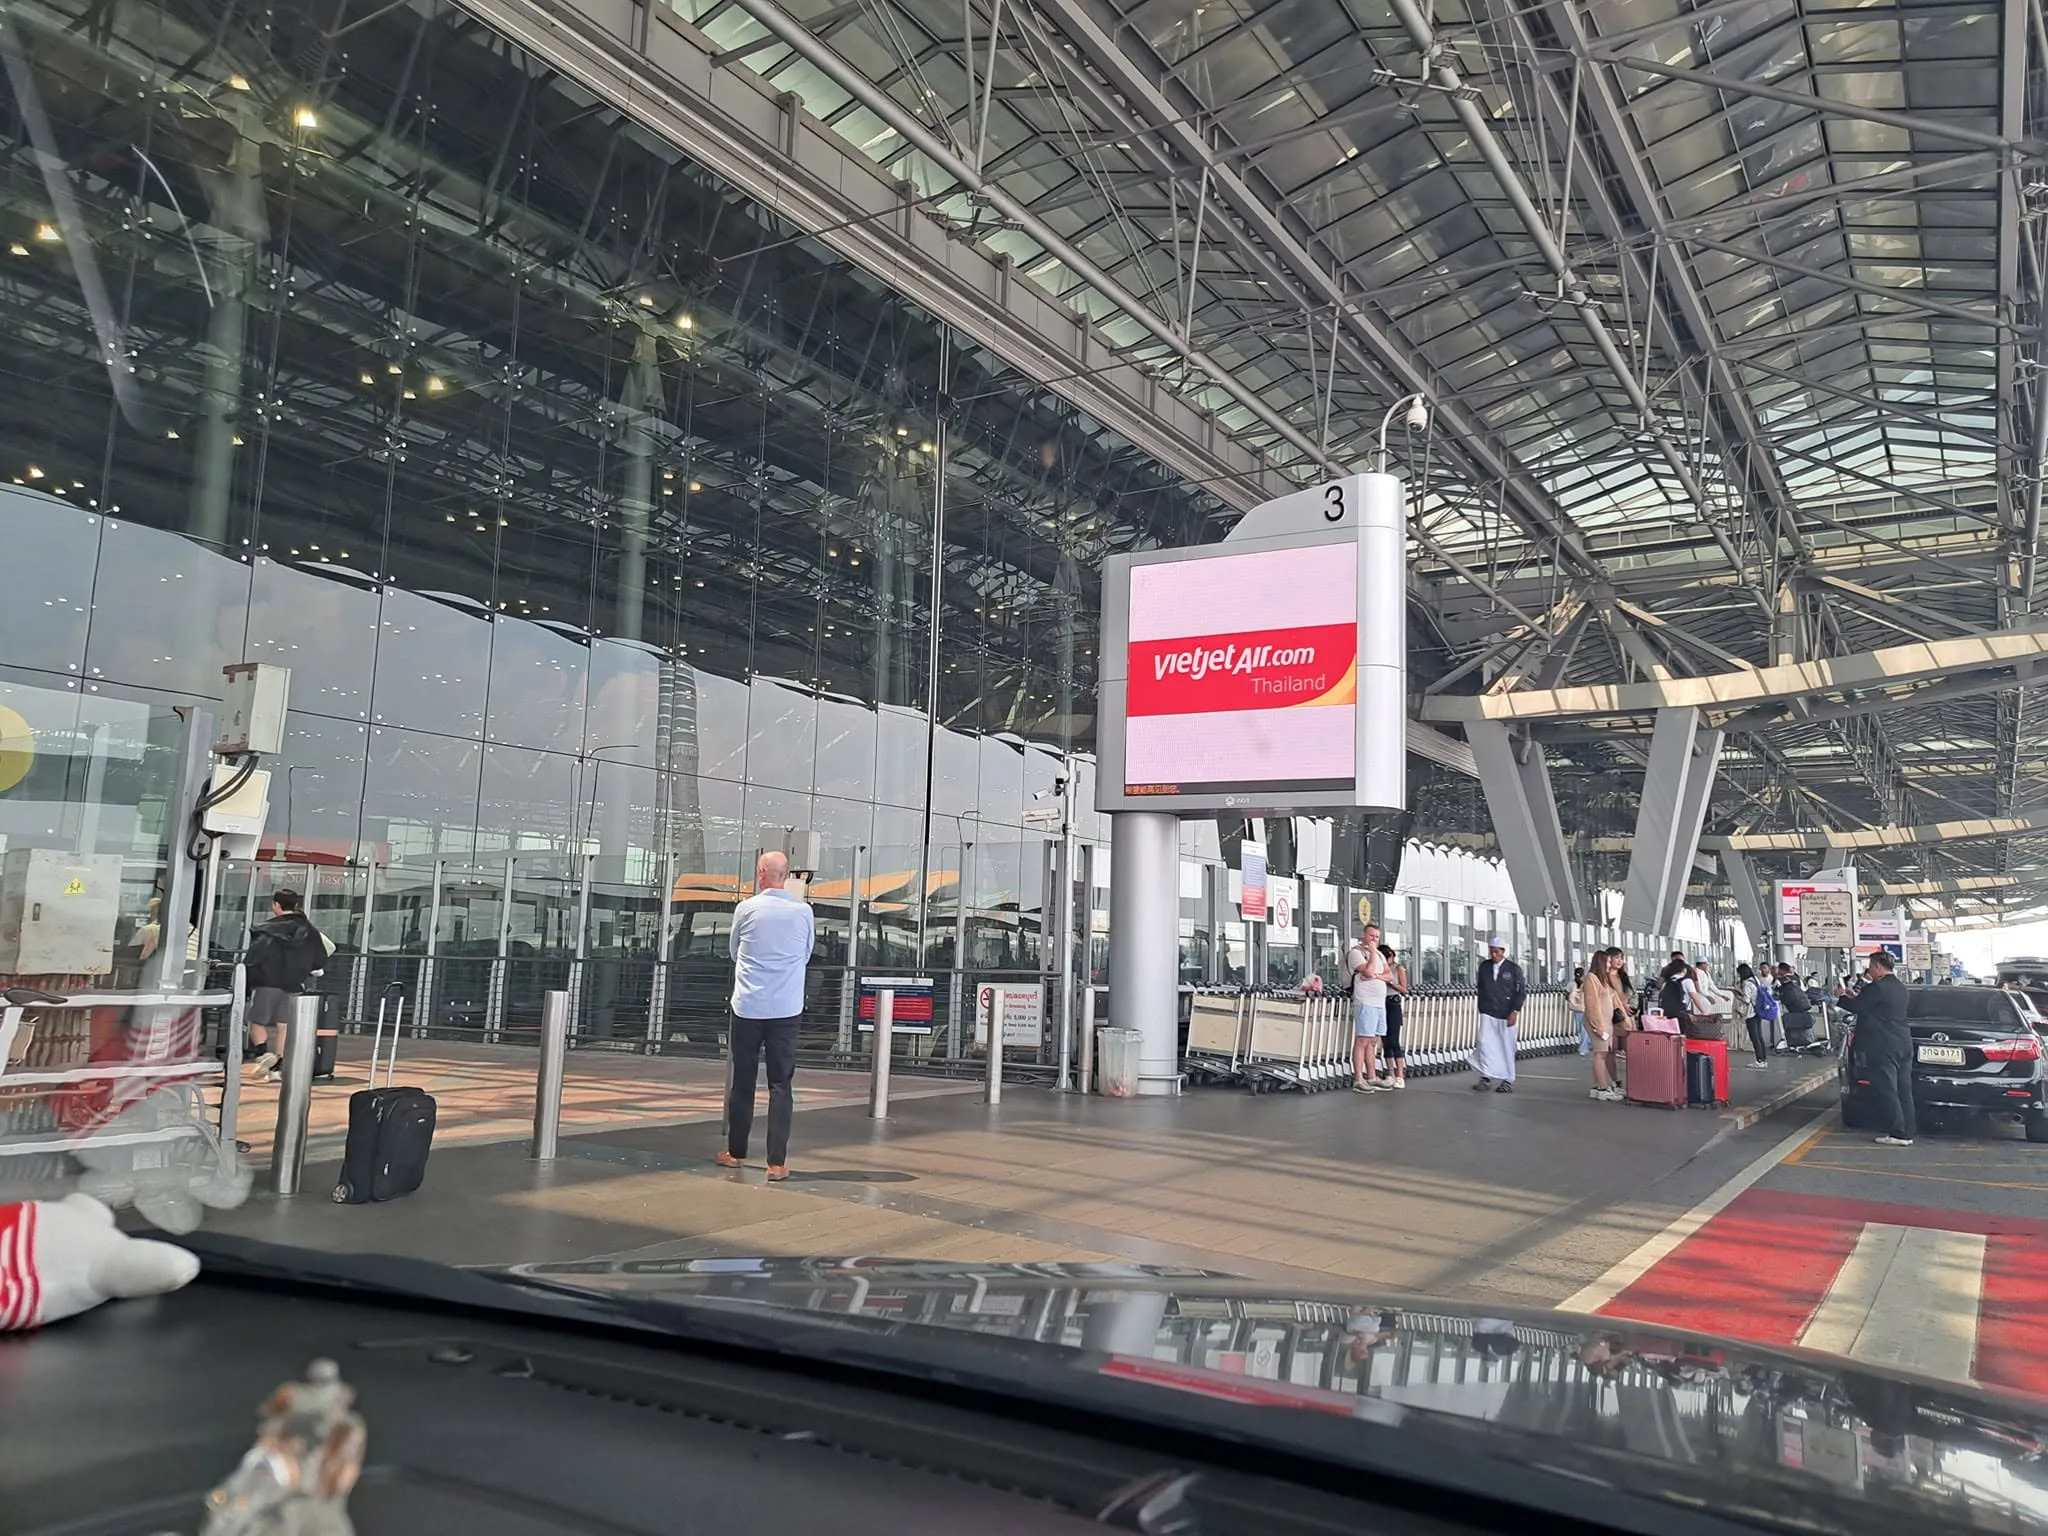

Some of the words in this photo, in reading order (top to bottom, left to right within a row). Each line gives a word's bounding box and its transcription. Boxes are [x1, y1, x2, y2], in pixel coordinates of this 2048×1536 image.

[1324, 485, 1345, 522] 3
[1251, 673, 1327, 695] Thailand
[1837, 869, 1844, 877] 4
